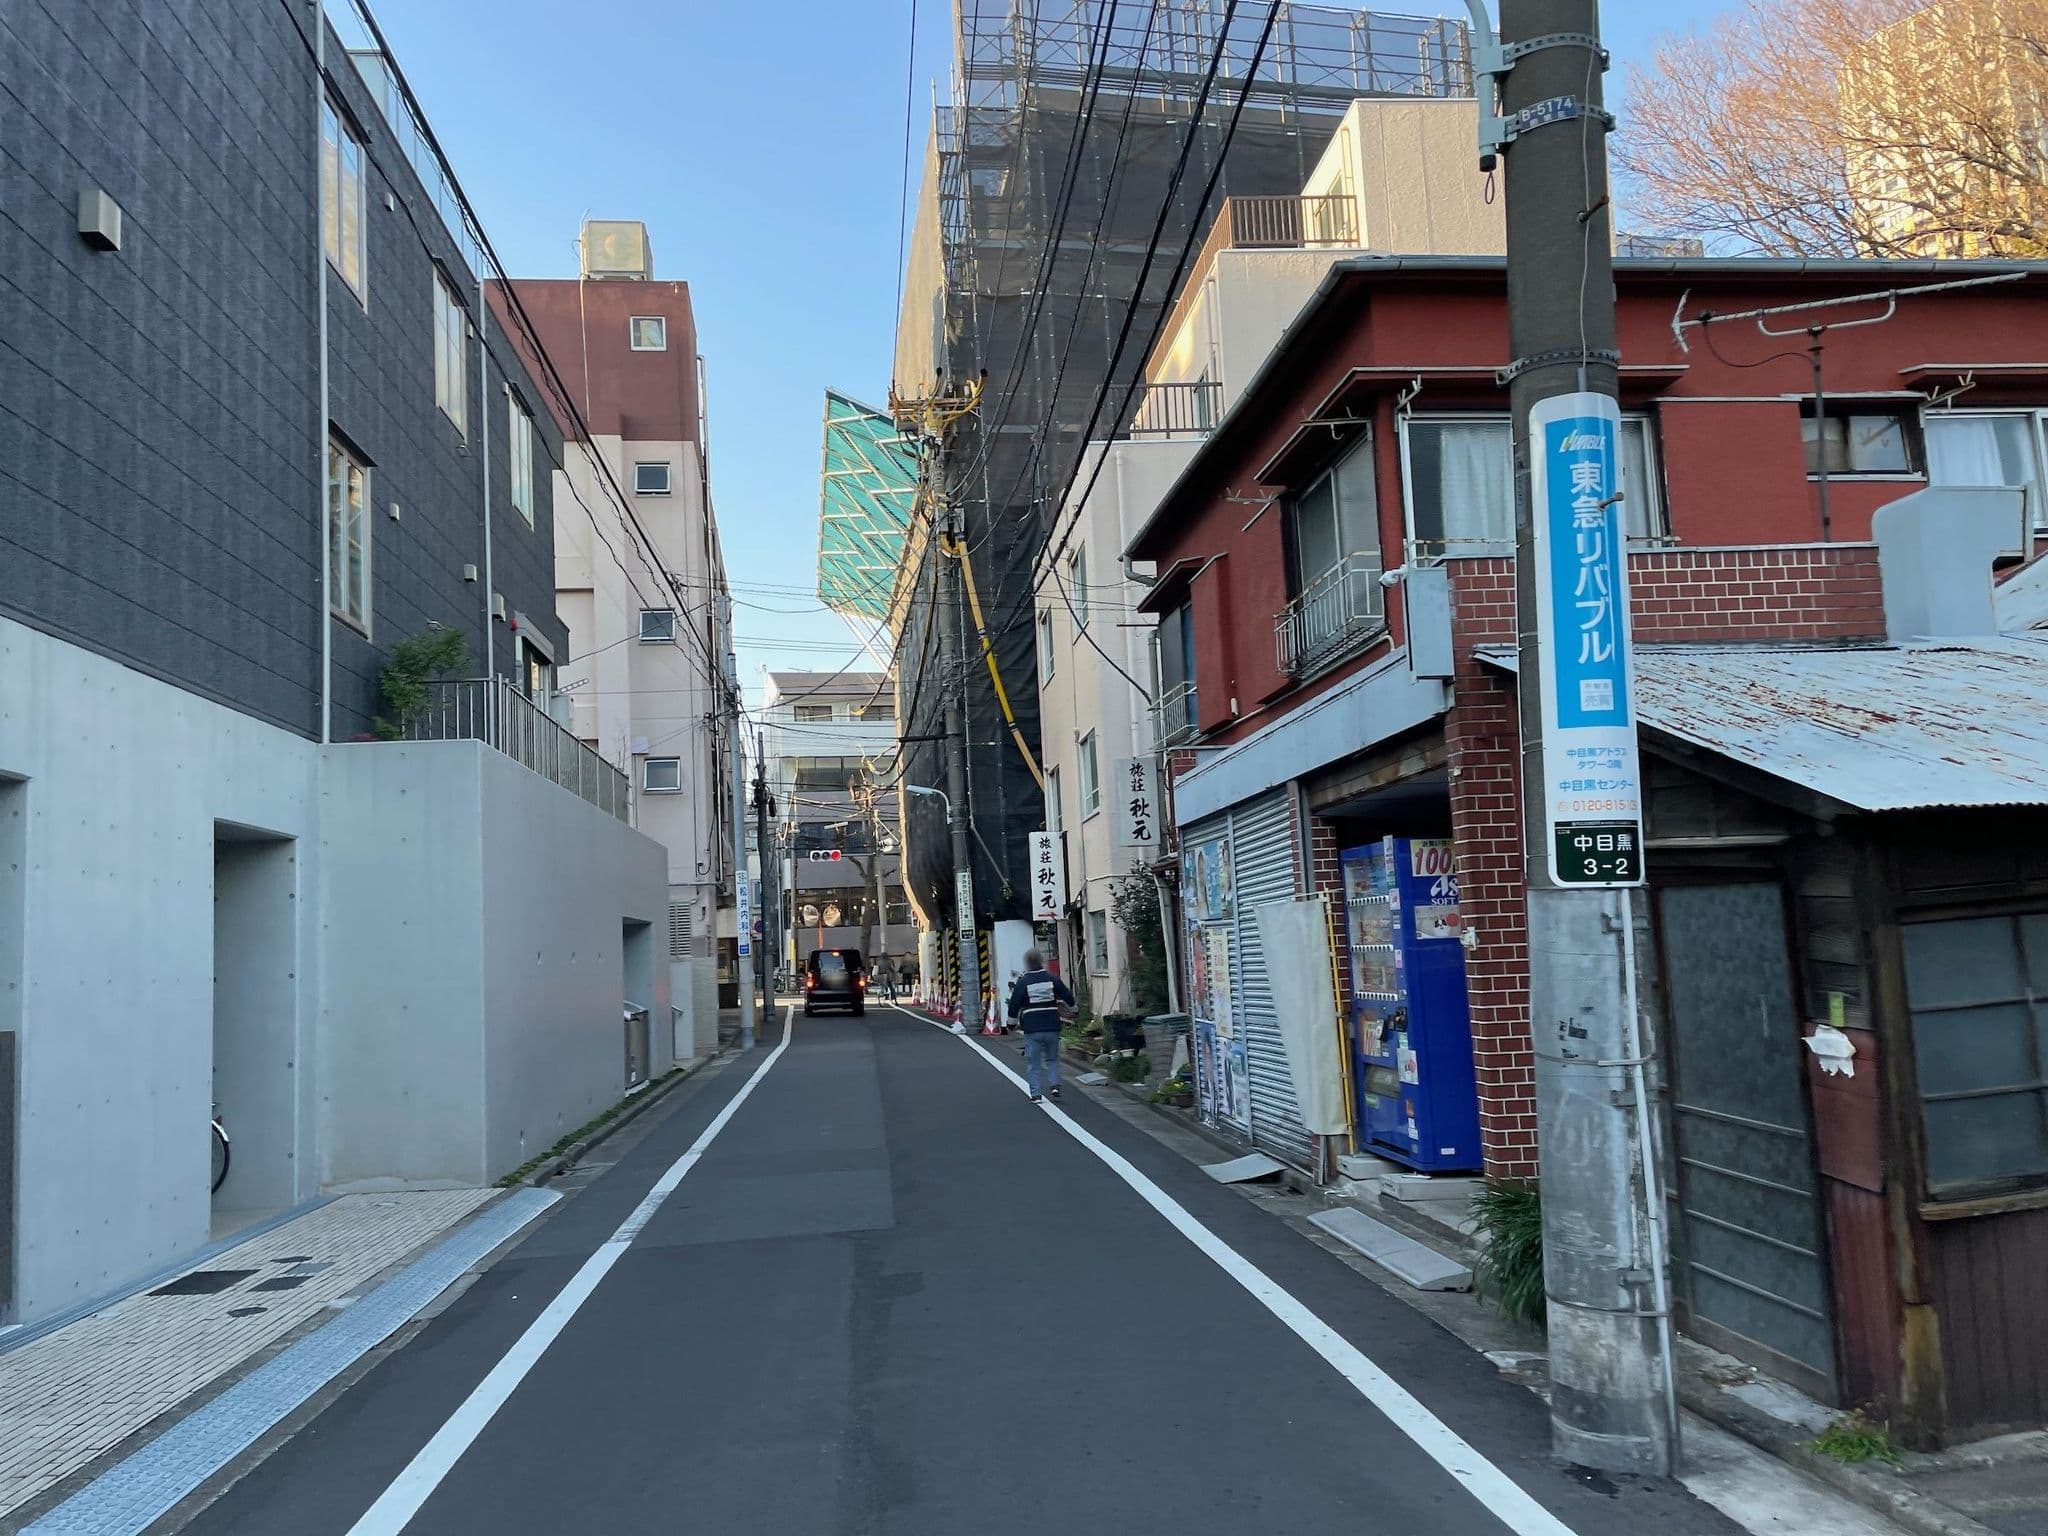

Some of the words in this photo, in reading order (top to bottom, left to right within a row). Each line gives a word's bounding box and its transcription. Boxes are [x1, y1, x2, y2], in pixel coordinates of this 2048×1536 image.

[1521, 98, 1572, 121] B-5174
[1569, 461, 1612, 664] 東急リバブル
[1574, 834, 1632, 852] 中目黒
[1415, 848, 1456, 875] 100
[1584, 858, 1628, 875] 3-2
